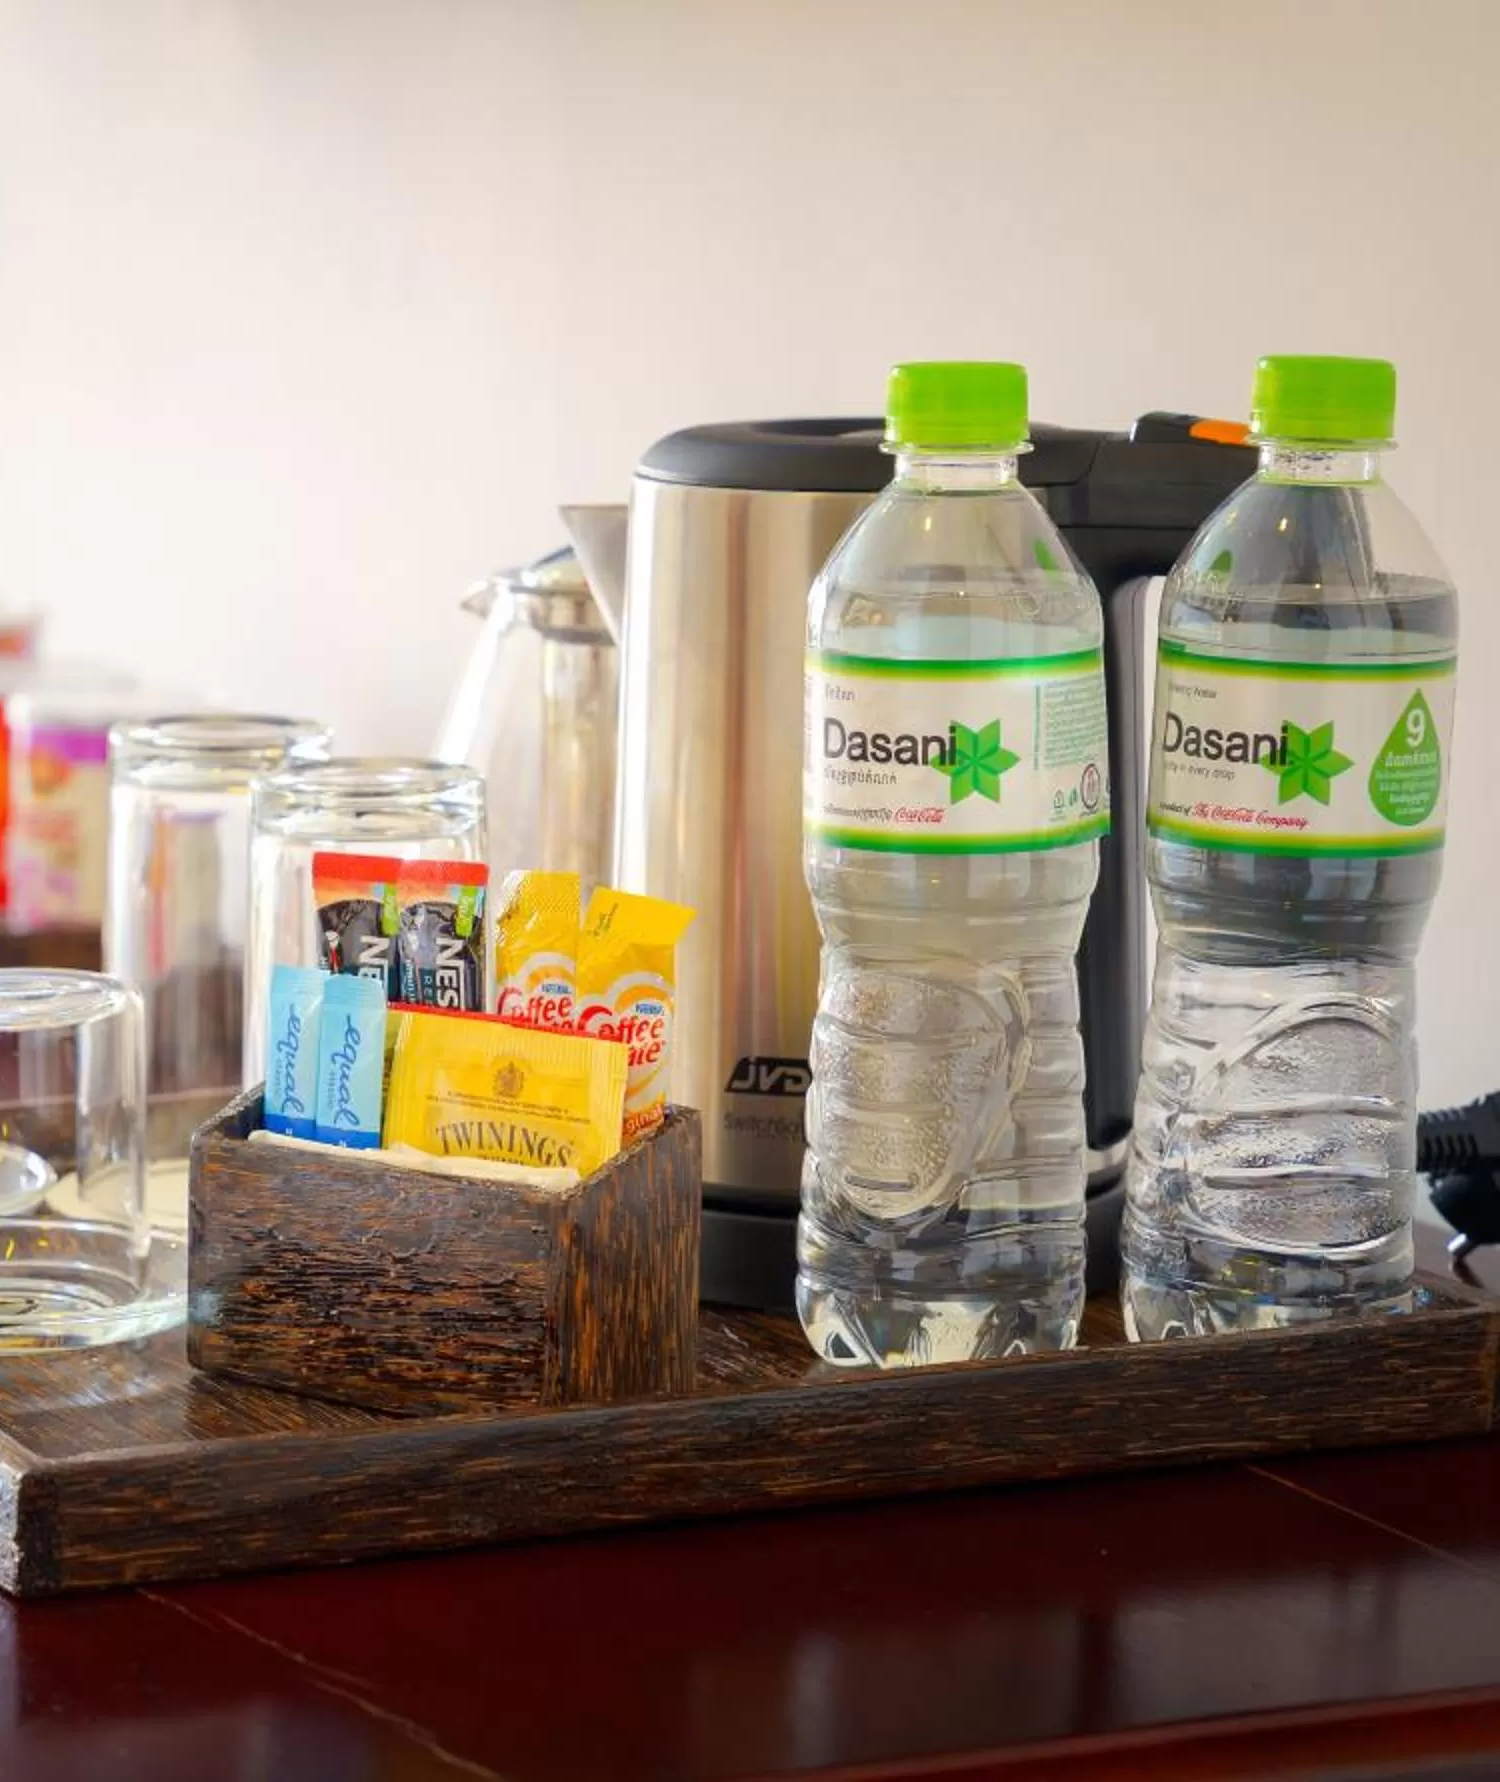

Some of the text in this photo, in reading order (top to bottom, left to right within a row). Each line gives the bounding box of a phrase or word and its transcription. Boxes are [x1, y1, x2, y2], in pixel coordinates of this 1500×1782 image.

[823, 717, 956, 766] Dasani
[1163, 711, 1288, 766] Dasani
[1406, 708, 1426, 748] 9
[894, 806, 945, 823] Coca-Cola
[276, 1003, 304, 1113] equal
[331, 1014, 361, 1126] equal
[436, 1120, 575, 1168] TWININGS
